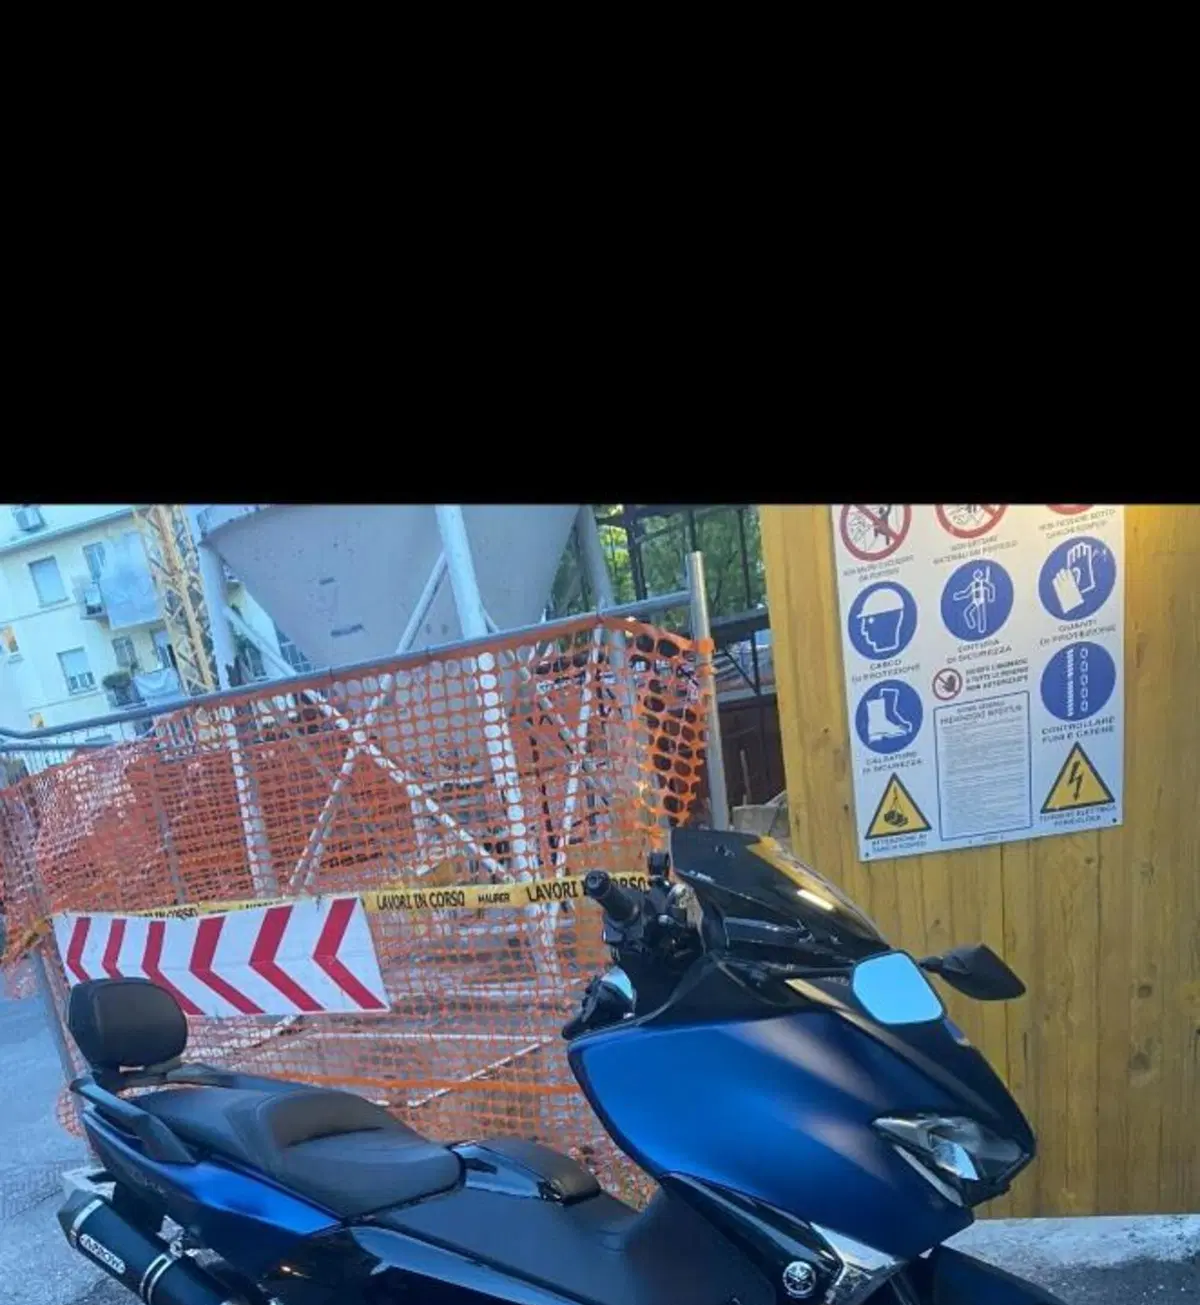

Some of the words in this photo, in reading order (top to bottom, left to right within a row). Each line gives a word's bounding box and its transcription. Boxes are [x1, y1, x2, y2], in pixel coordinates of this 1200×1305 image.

[376, 892, 413, 911] LAVORI
[429, 890, 465, 909] CORSO
[525, 880, 579, 902] LAVORI
